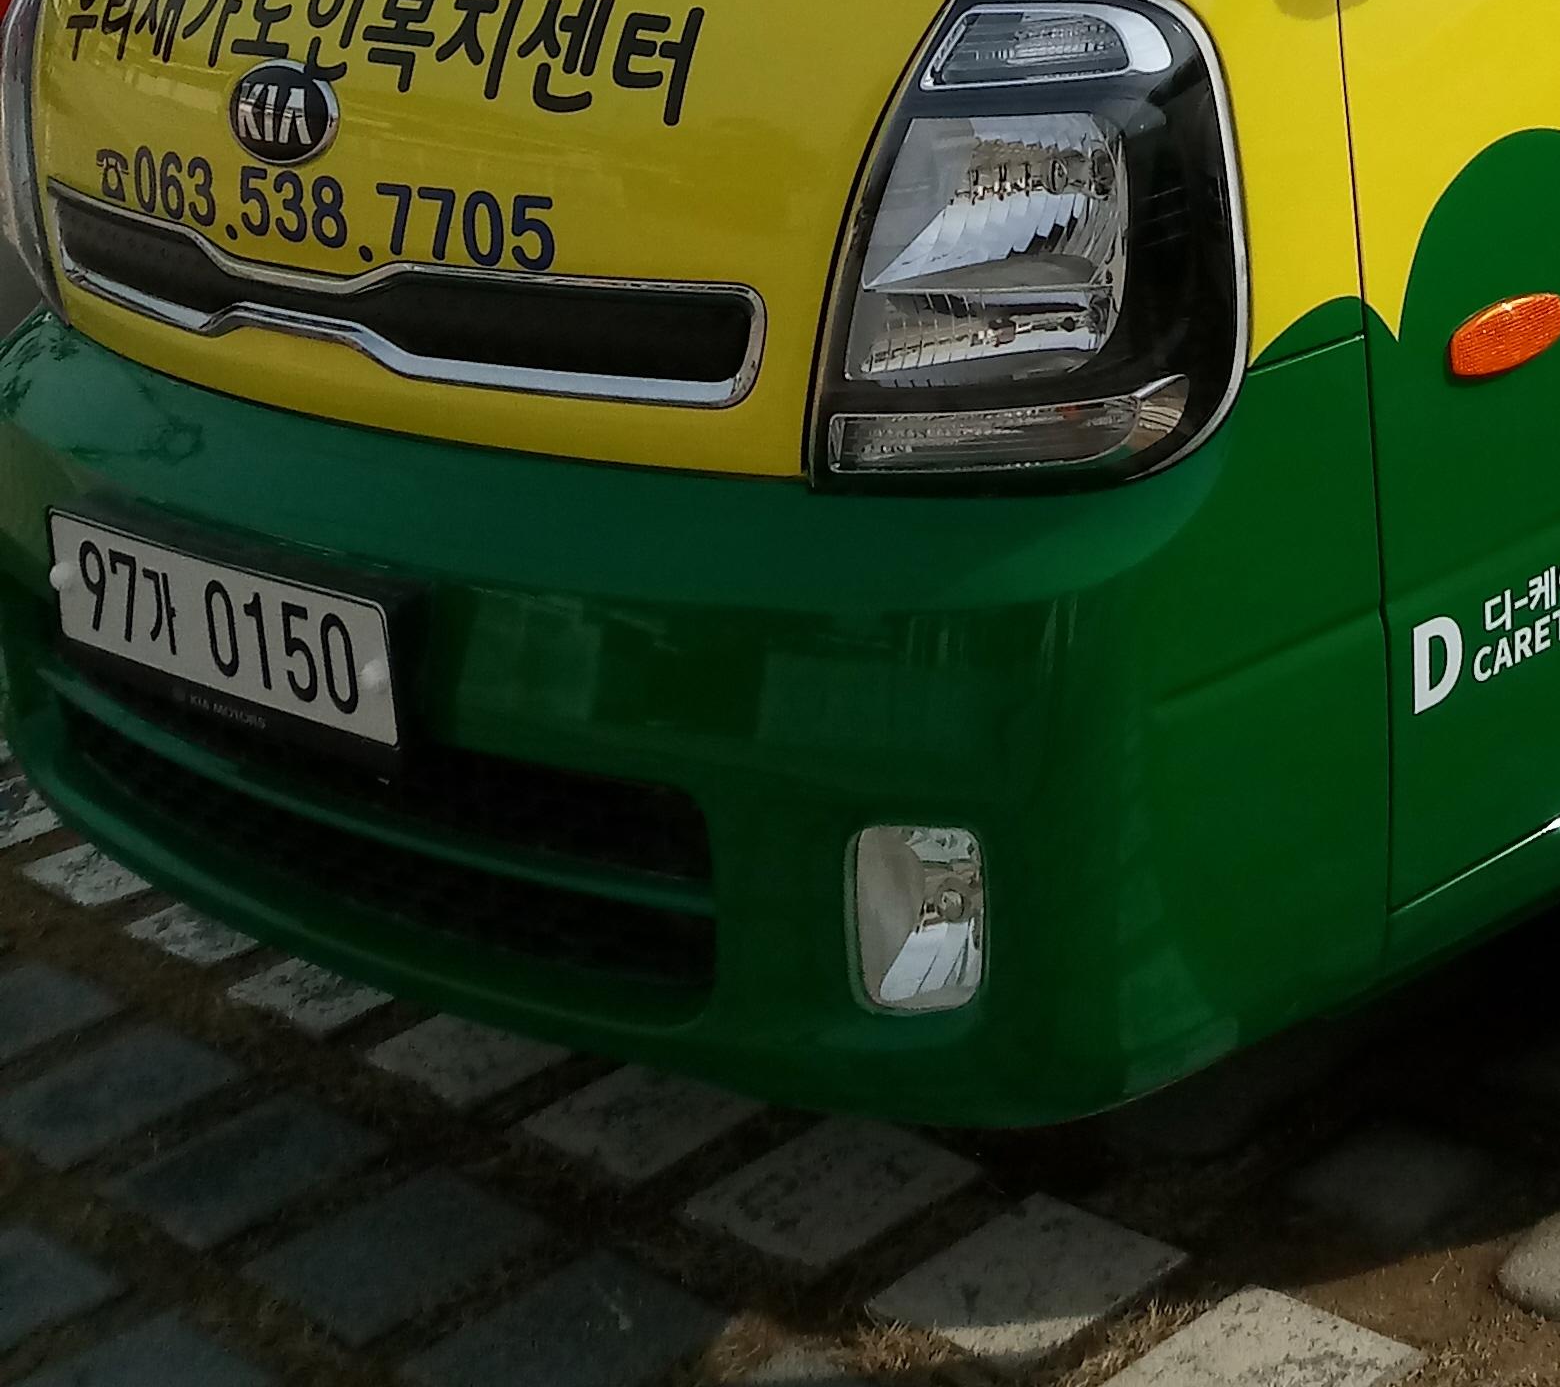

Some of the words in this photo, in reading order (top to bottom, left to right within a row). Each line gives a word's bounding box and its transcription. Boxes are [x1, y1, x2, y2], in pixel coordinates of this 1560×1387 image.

[237, 81, 313, 146] KIA
[134, 145, 557, 272] 063.538.7705
[79, 539, 178, 656] 97가
[204, 579, 360, 716] 0150
[1412, 615, 1464, 716] D
